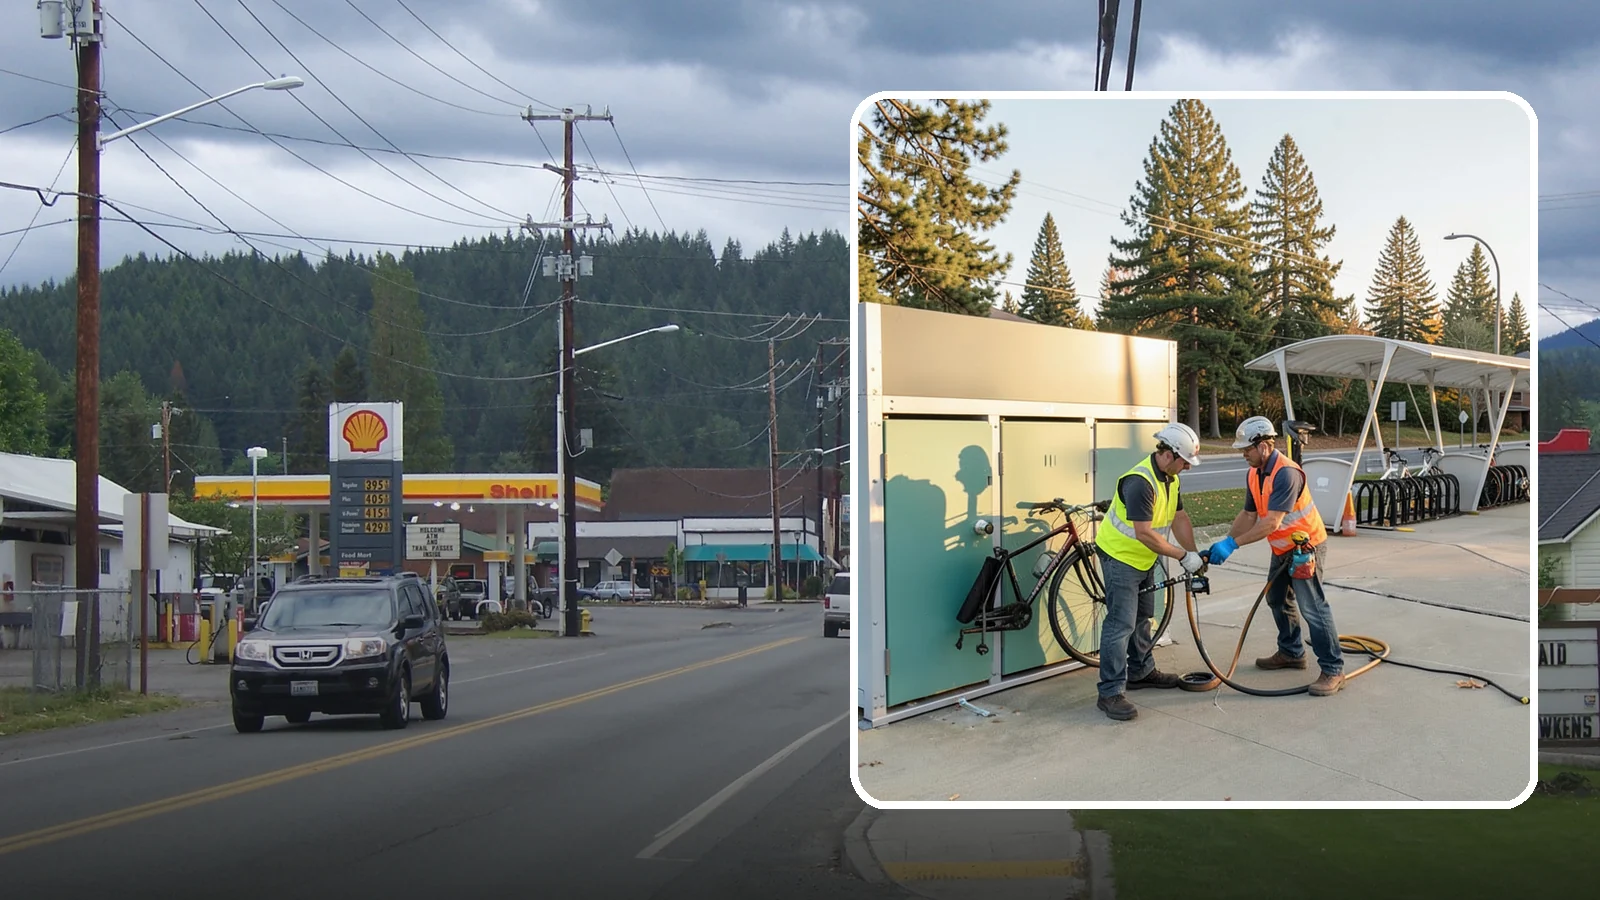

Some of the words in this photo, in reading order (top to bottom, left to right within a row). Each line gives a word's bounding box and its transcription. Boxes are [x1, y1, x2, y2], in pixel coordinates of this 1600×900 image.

[366, 480, 383, 490] 395
[490, 484, 547, 498] Shell
[366, 494, 383, 504] 405
[366, 508, 383, 518] 415
[366, 522, 383, 532] 429
[1538, 643, 1566, 665] AID
